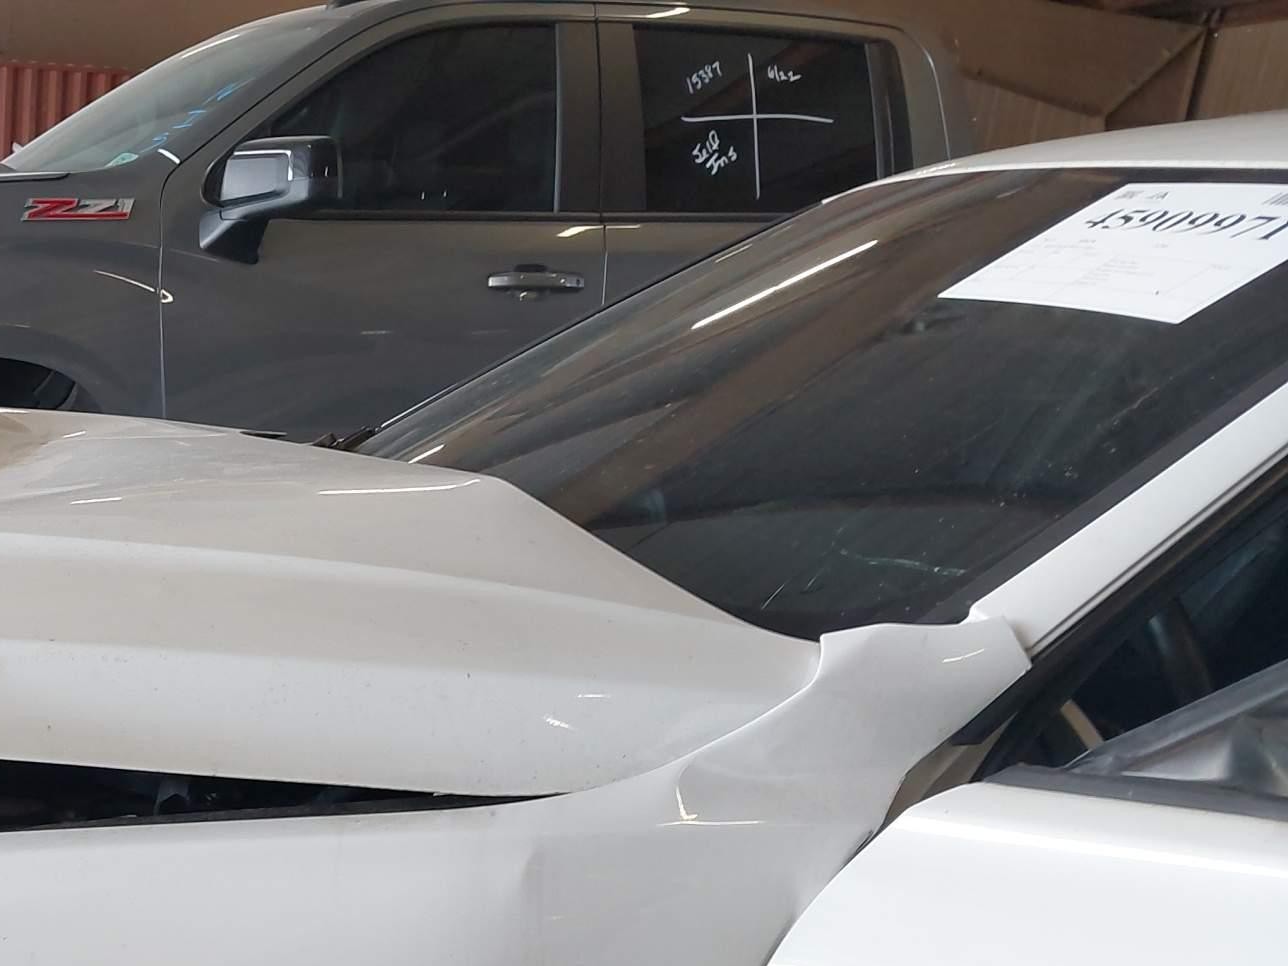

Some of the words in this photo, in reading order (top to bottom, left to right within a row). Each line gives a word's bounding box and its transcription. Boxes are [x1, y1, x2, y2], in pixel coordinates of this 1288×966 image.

[686, 61, 722, 94] 15387
[767, 64, 801, 82] 6/22
[20, 198, 135, 221] Z71
